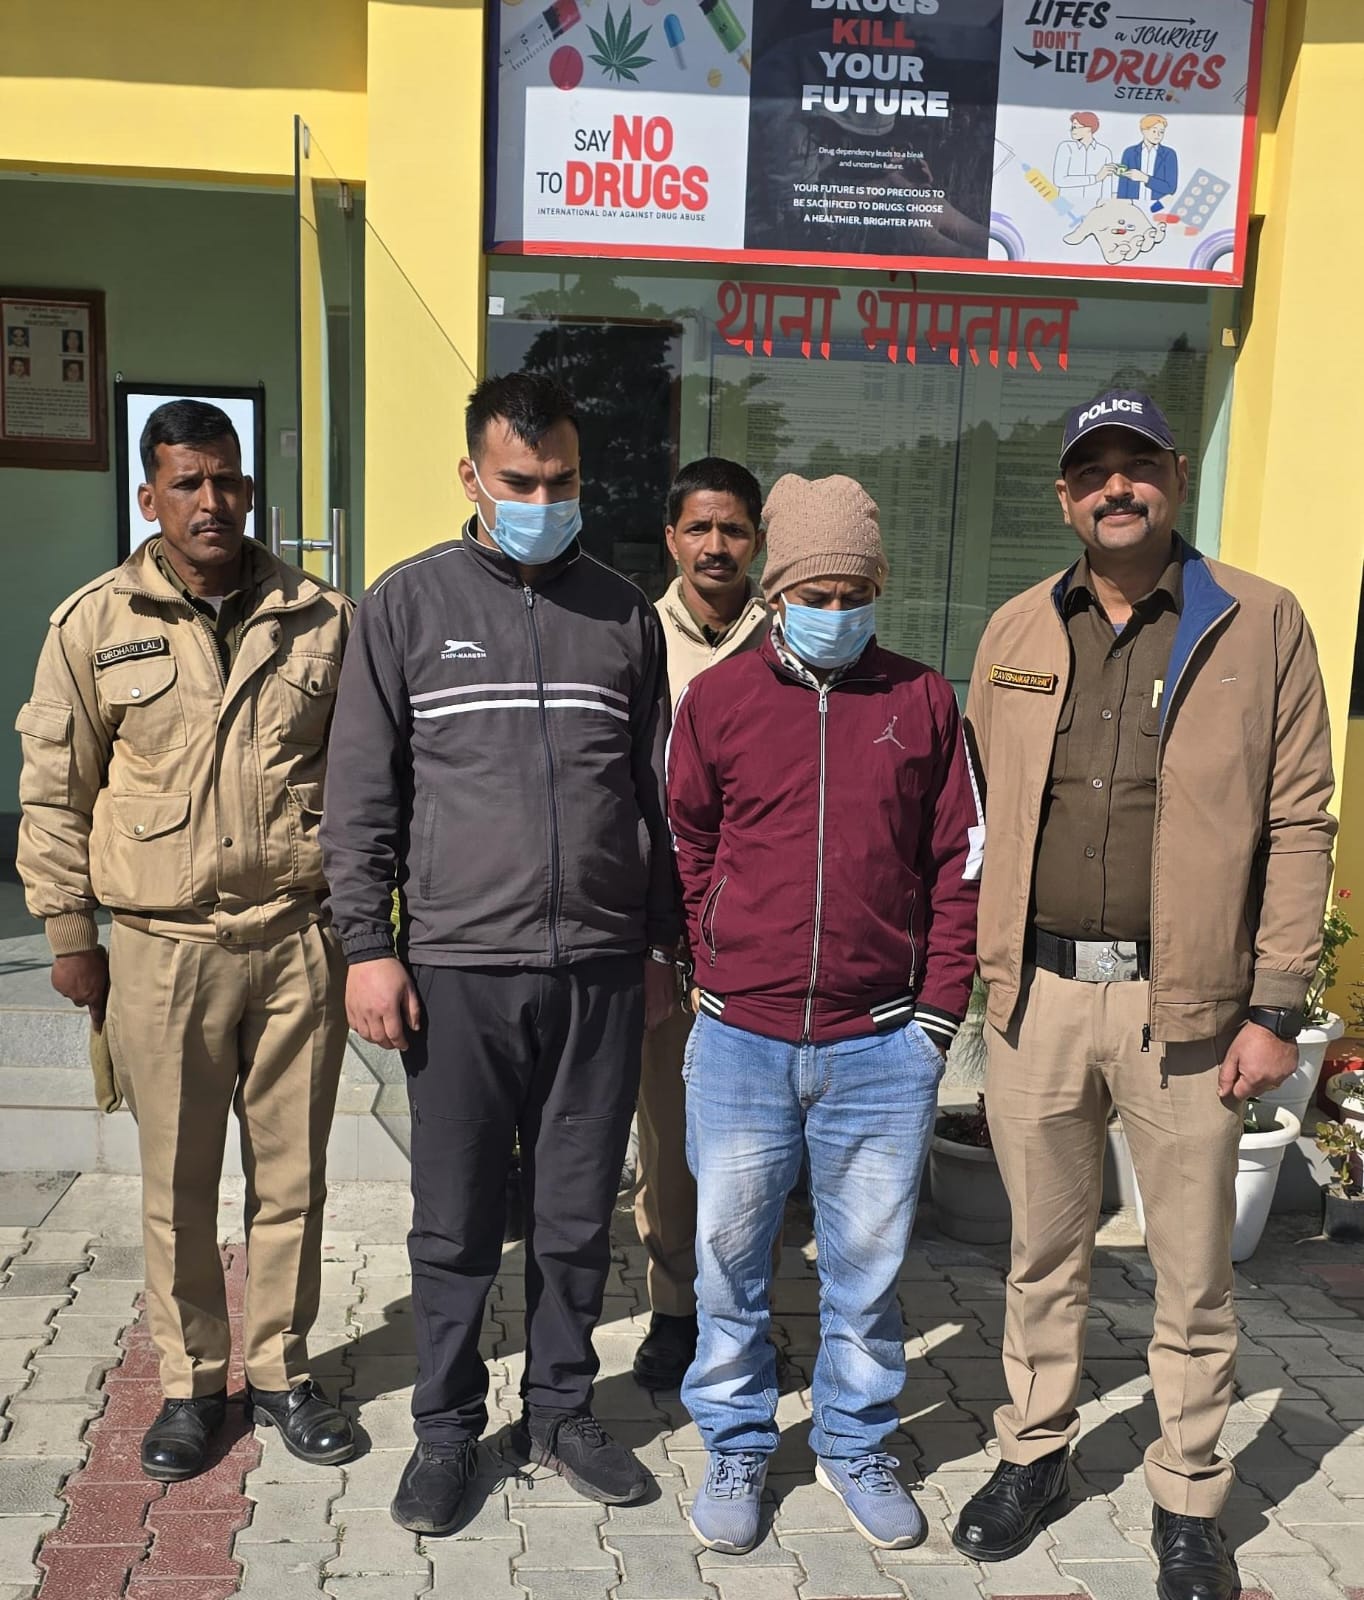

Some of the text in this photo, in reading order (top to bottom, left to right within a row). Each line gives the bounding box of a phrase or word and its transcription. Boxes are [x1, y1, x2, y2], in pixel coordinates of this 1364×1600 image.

[1025, 0, 1111, 29] LIFES
[832, 18, 916, 48] KILL
[1032, 30, 1081, 50] DON'T
[1114, 25, 1219, 53] a JOURNEY
[818, 51, 924, 83] YOUR
[1055, 47, 1226, 91] LET DRUGS
[801, 84, 950, 118] FUTURE
[1114, 86, 1166, 102] STEER
[574, 114, 674, 163] SAY NO
[818, 146, 835, 156] Drug
[835, 147, 875, 158] dependency
[875, 149, 893, 158] leads
[893, 150, 901, 158] to
[852, 160, 882, 169] uncertain
[536, 160, 709, 212] TO DRUGS
[793, 183, 945, 199] YOUR FUTURE IS TOO PRECIOUS TO
[537, 207, 706, 222] INTERNATIONAL DAY AGAINST DRUG ABUSE
[793, 198, 805, 207] BE
[806, 198, 857, 209] SACRIFICED
[857, 201, 871, 210] TO
[905, 203, 944, 214] CHOOSE
[803, 213, 811, 222] A
[863, 216, 907, 227] BRIGHTER
[715, 280, 841, 361] थाना
[1078, 398, 1144, 430] POLICE
[141, 641, 158, 651] LAL
